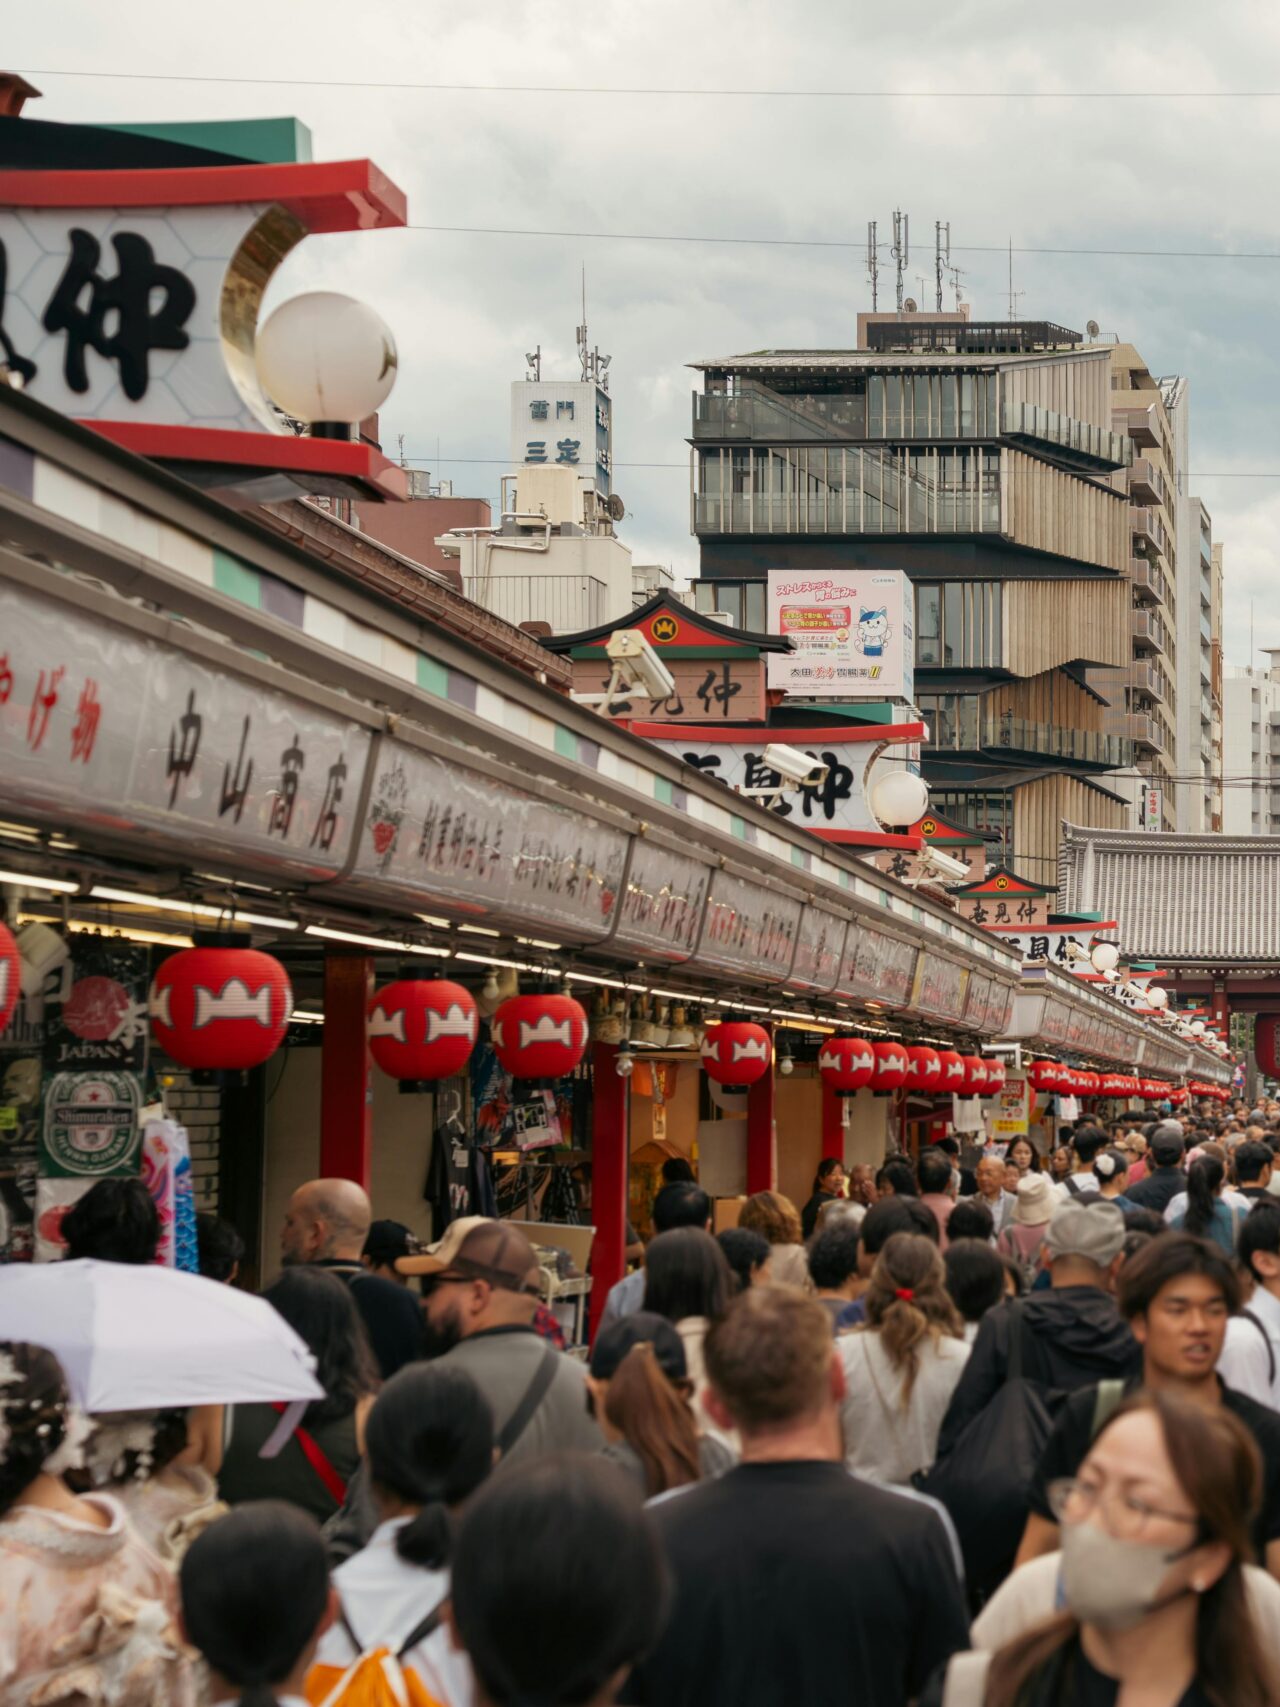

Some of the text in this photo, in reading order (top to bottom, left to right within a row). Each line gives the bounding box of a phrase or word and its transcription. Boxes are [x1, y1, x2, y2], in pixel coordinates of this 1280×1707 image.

[529, 400, 575, 421] 雷門
[524, 438, 581, 464] 三定
[166, 688, 347, 852] 中山商店
[57, 1043, 122, 1063] JAPAN
